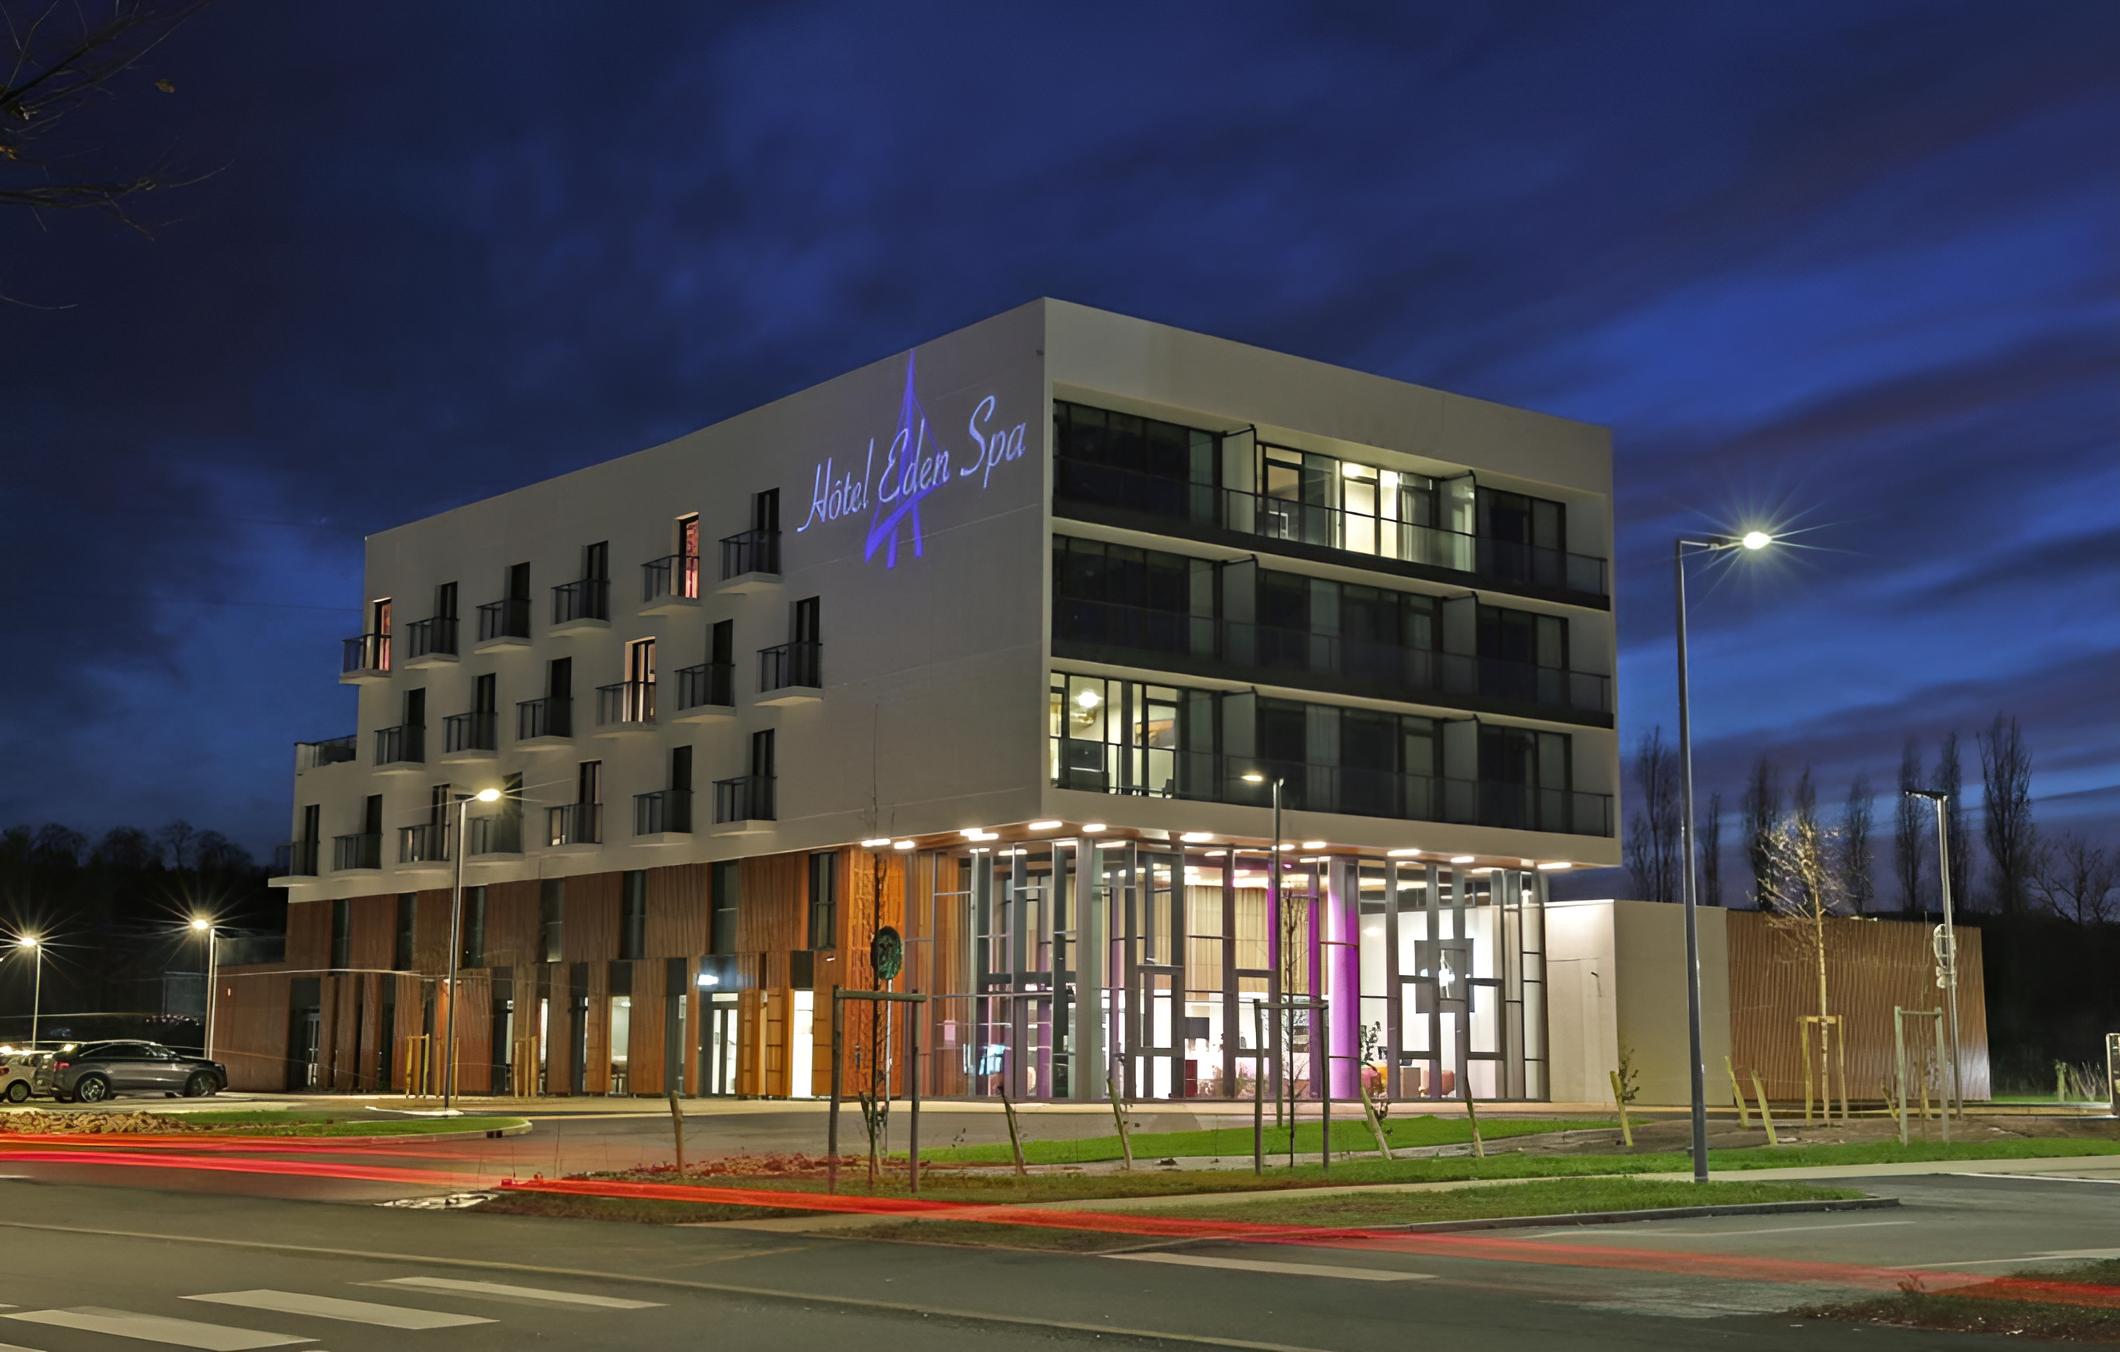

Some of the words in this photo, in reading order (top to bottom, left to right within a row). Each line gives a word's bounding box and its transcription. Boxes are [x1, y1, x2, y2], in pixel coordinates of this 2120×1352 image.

[797, 437, 874, 532] Hôtel
[879, 418, 950, 503] Eden
[960, 395, 1027, 488] Spa
